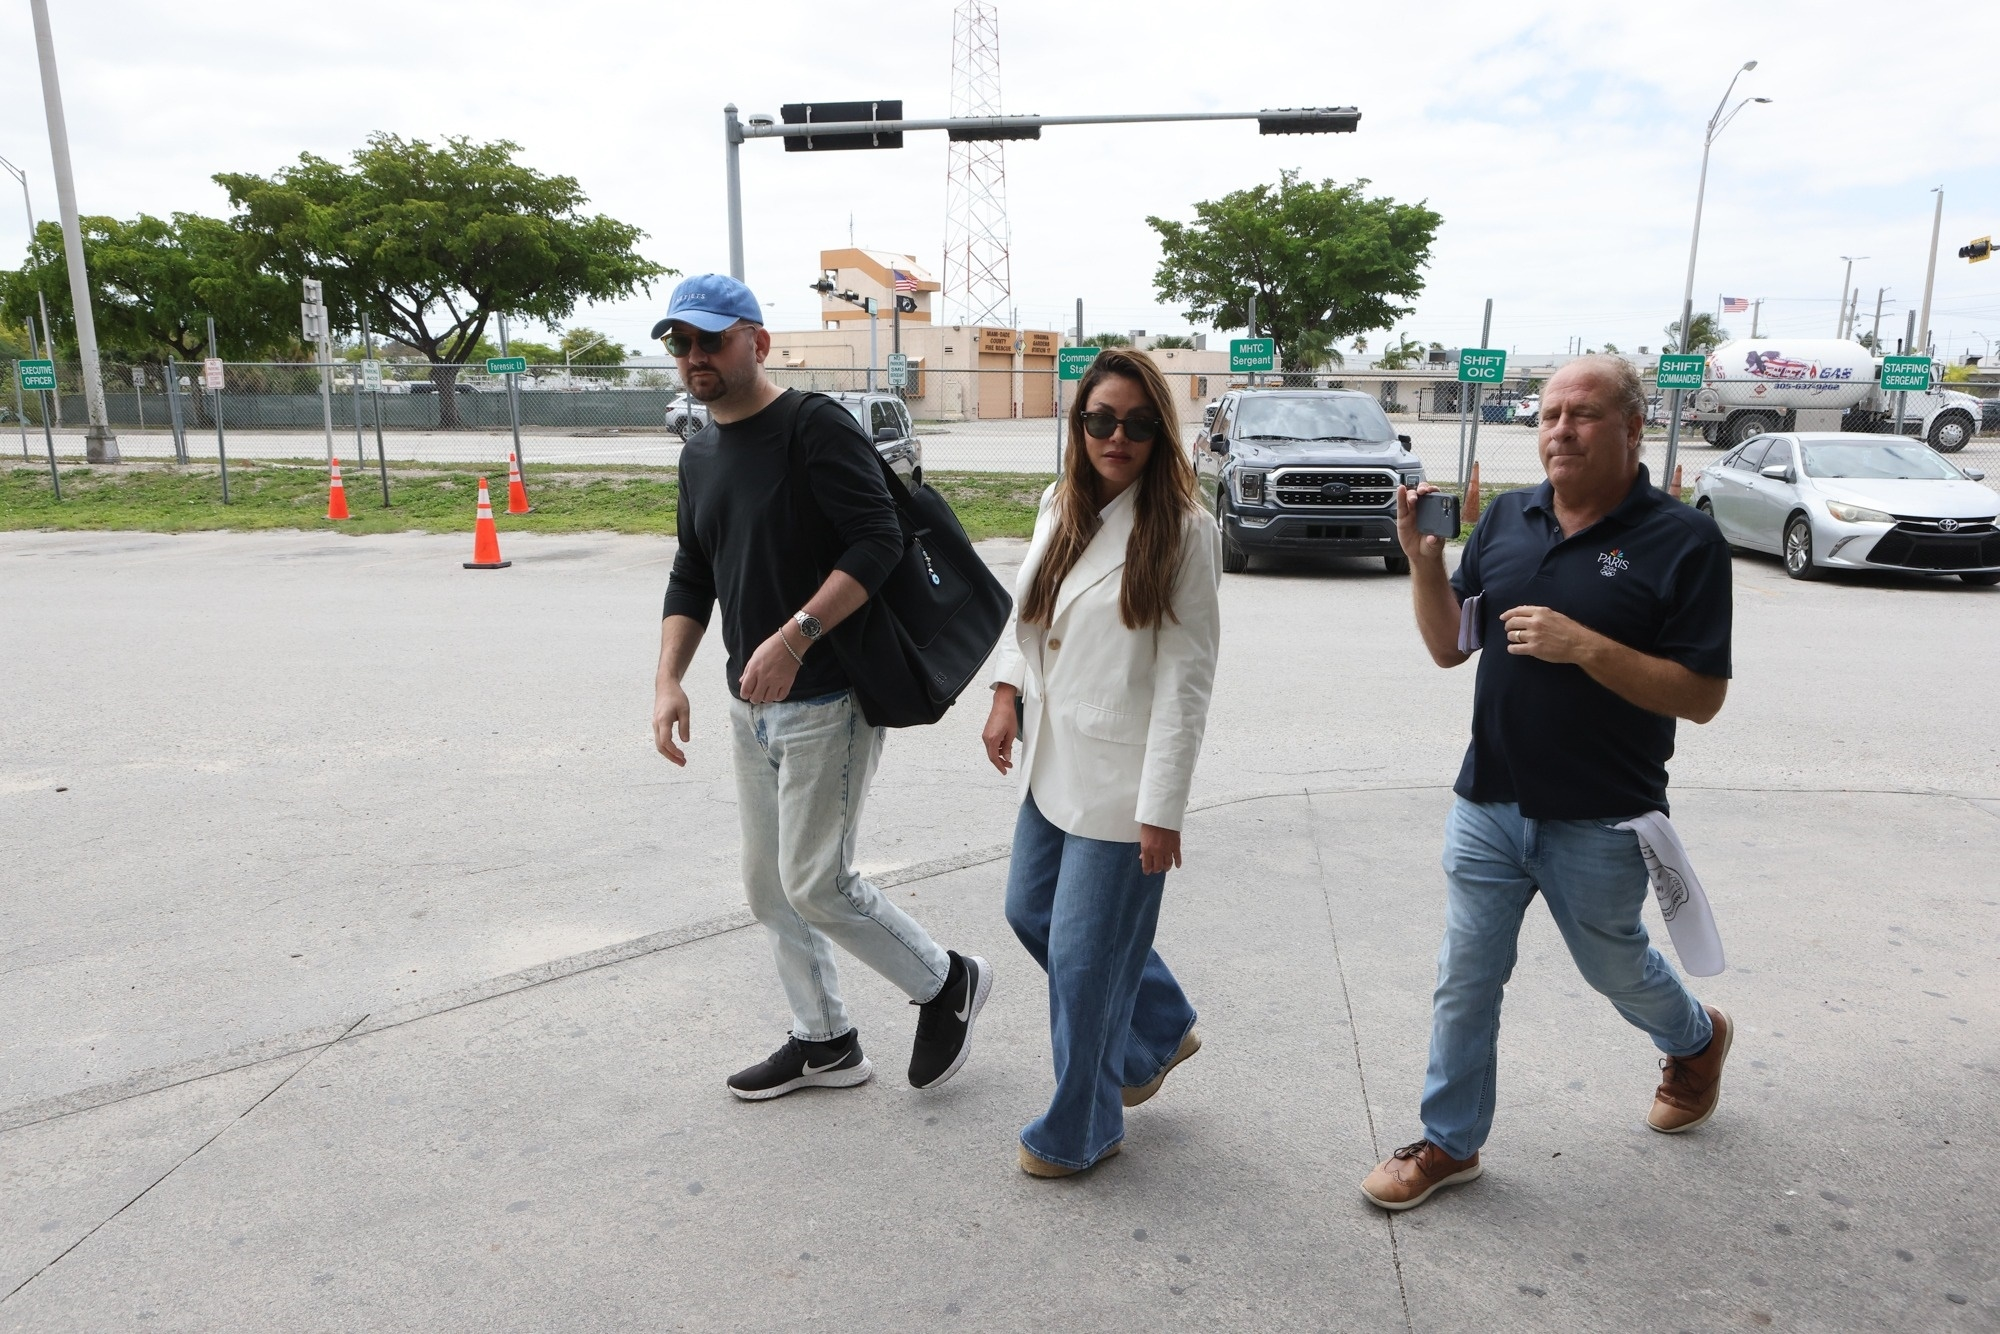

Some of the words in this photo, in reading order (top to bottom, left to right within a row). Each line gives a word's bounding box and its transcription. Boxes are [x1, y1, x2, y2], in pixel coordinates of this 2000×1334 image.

[1239, 344, 1264, 353] MHTC
[491, 362, 514, 371] Forensic
[516, 361, 523, 370] Lt
[1233, 356, 1271, 367] Sergeant
[1463, 355, 1503, 366] SHIFT
[21, 366, 53, 375] EXECUTIVE
[1070, 364, 1088, 374] Staf
[1662, 361, 1702, 372] SHIFT
[1884, 363, 1929, 374] STAFFING
[1467, 367, 1496, 378] OIC
[1819, 367, 1853, 379] GAS
[25, 376, 53, 385] OFFICER
[1659, 374, 1701, 384] COMMANDER
[1885, 375, 1924, 386] SERGEANT
[1597, 552, 1629, 570] PARIS
[1603, 564, 1617, 573] 2024
